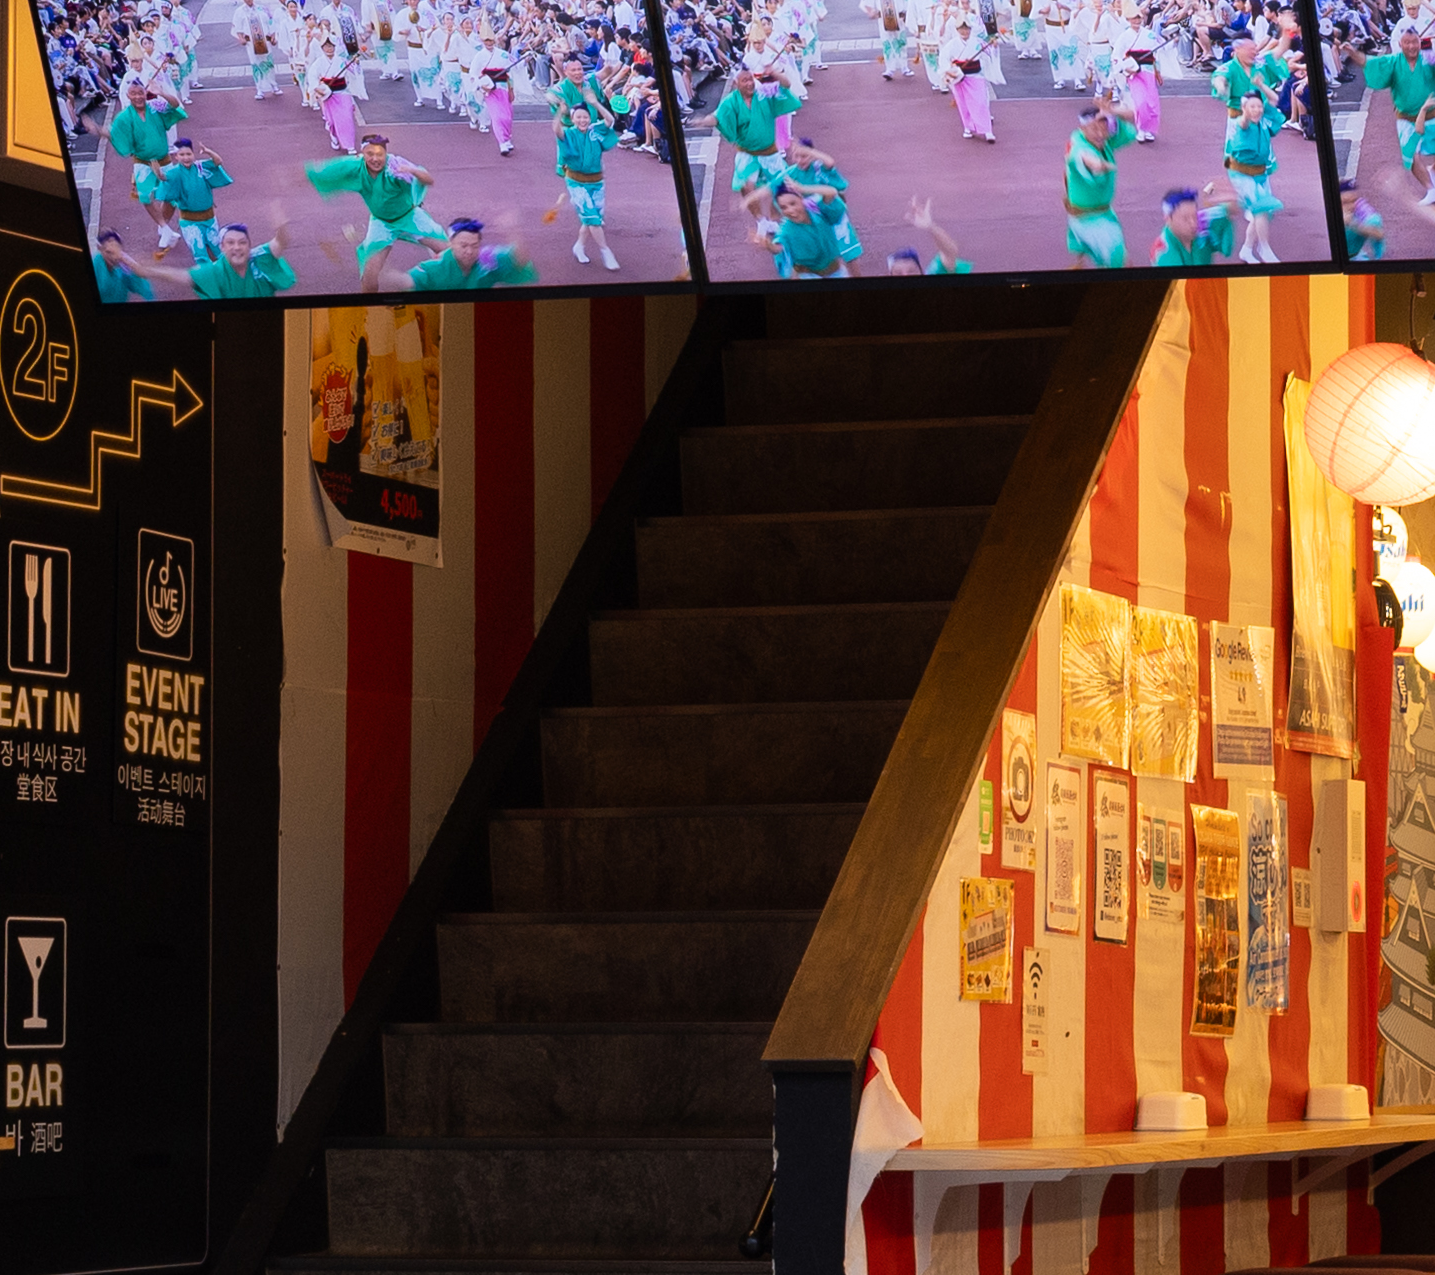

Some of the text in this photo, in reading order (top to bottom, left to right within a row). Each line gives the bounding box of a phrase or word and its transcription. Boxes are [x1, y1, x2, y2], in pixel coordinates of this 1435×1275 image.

[12, 297, 70, 403] 2F
[152, 585, 179, 612] LIVE
[126, 662, 205, 715] EVENT
[55, 690, 81, 734] IN
[123, 710, 202, 762] STAGE
[16, 741, 31, 769] 내
[32, 741, 58, 771] 식사
[60, 745, 87, 773] 공간
[16, 772, 58, 802] 堂食区
[117, 763, 207, 801] 이벤트 스테이지
[137, 796, 186, 827] 活动舞台
[5, 1062, 64, 1108] BAR
[30, 1120, 64, 1154] 酒吧
